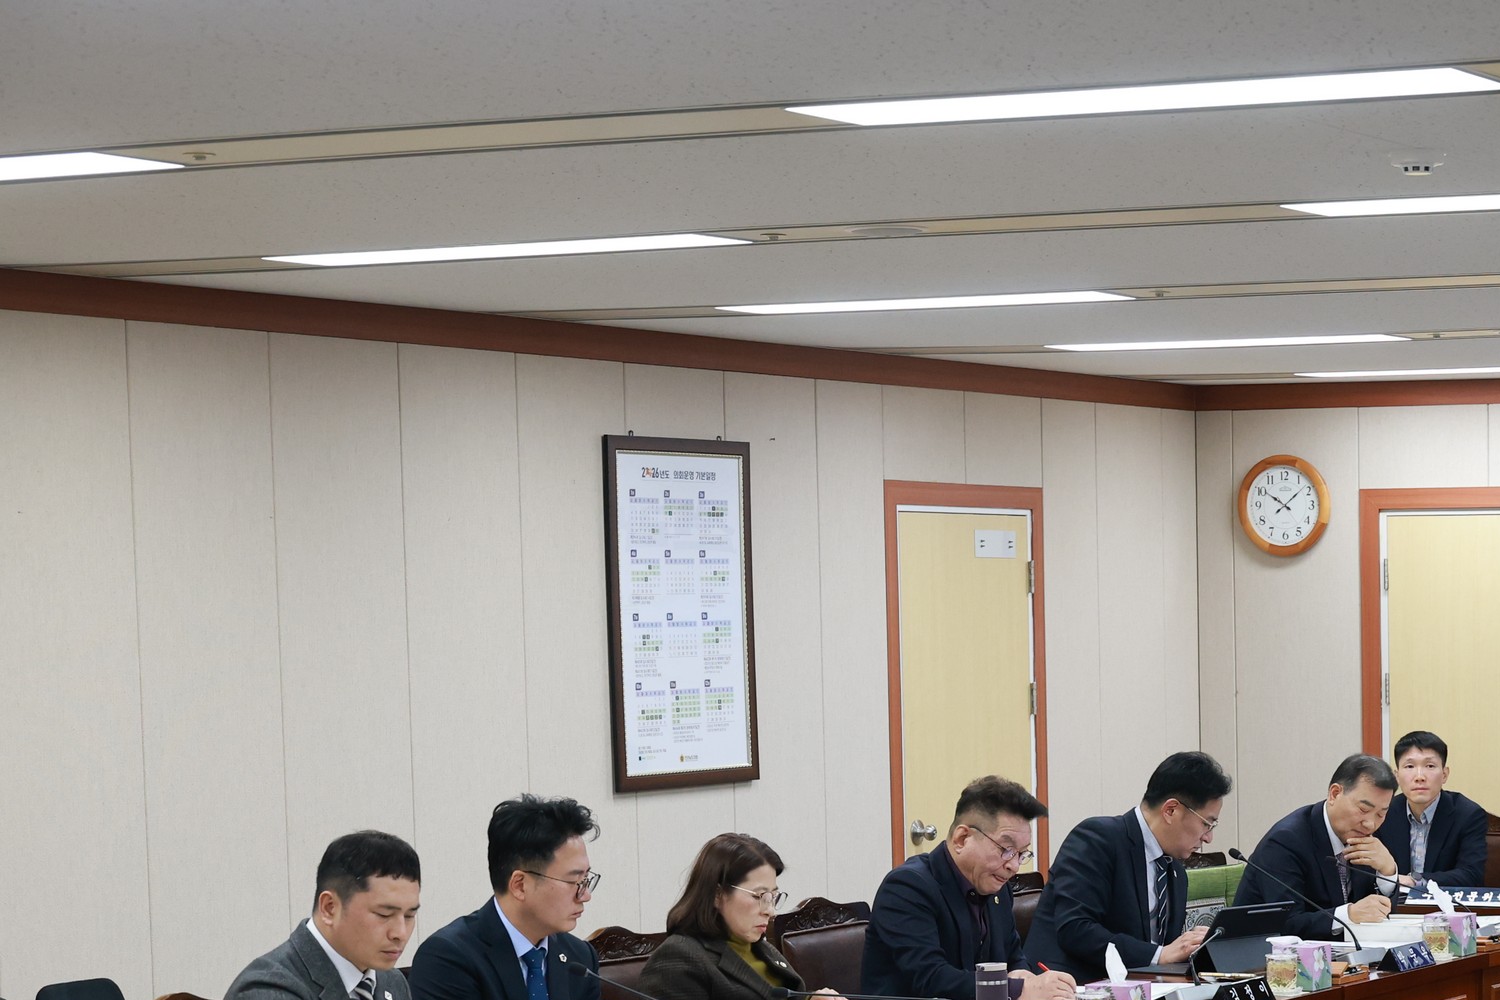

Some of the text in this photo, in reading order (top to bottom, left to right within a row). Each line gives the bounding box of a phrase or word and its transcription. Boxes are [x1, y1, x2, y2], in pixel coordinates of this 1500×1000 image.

[1266, 475, 1274, 485] 11
[1280, 471, 1289, 481] 12
[1257, 486, 1267, 497] 10
[1306, 486, 1312, 496] 2
[1255, 501, 1262, 511] 9
[1308, 500, 1315, 510] 3
[1259, 515, 1266, 526] 8
[1304, 515, 1310, 525] 4
[1269, 527, 1274, 537] 7
[1282, 531, 1289, 540] 6
[1295, 527, 1302, 537] 5
